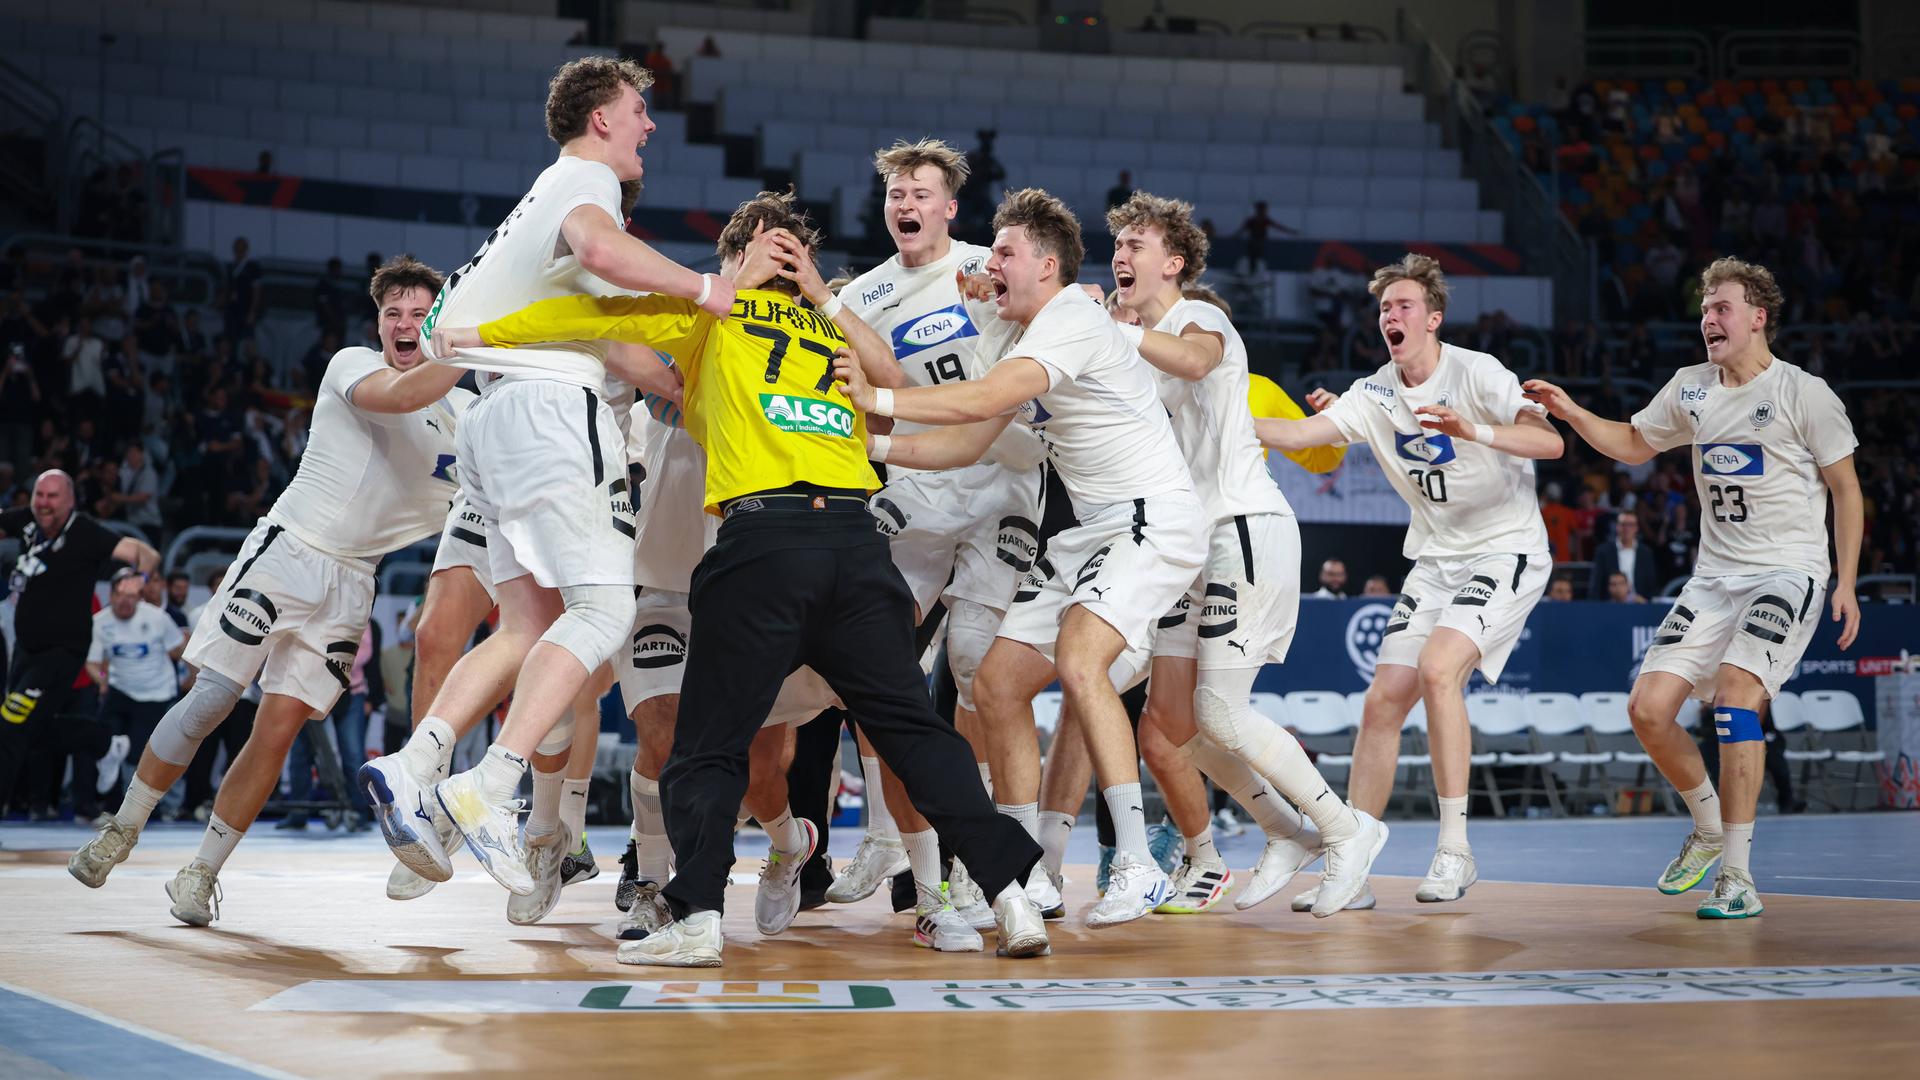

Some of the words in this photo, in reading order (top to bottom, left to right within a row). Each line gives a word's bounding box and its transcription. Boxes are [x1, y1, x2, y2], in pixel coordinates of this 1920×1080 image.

[863, 281, 894, 305] hella
[914, 318, 953, 339] TENA
[742, 323, 842, 395] 77
[924, 353, 967, 385] 19
[1364, 381, 1395, 398] hella
[765, 396, 853, 436] ALSCO
[1711, 454, 1739, 465] TENA
[1709, 485, 1747, 522] 23
[998, 534, 1036, 557] HARTING
[226, 602, 271, 635] HARTING
[1801, 660, 1857, 674] SPORTS
[931, 980, 1188, 989] EGYPT
[1219, 979, 1316, 987] OF
[1342, 974, 1560, 984] BANK
